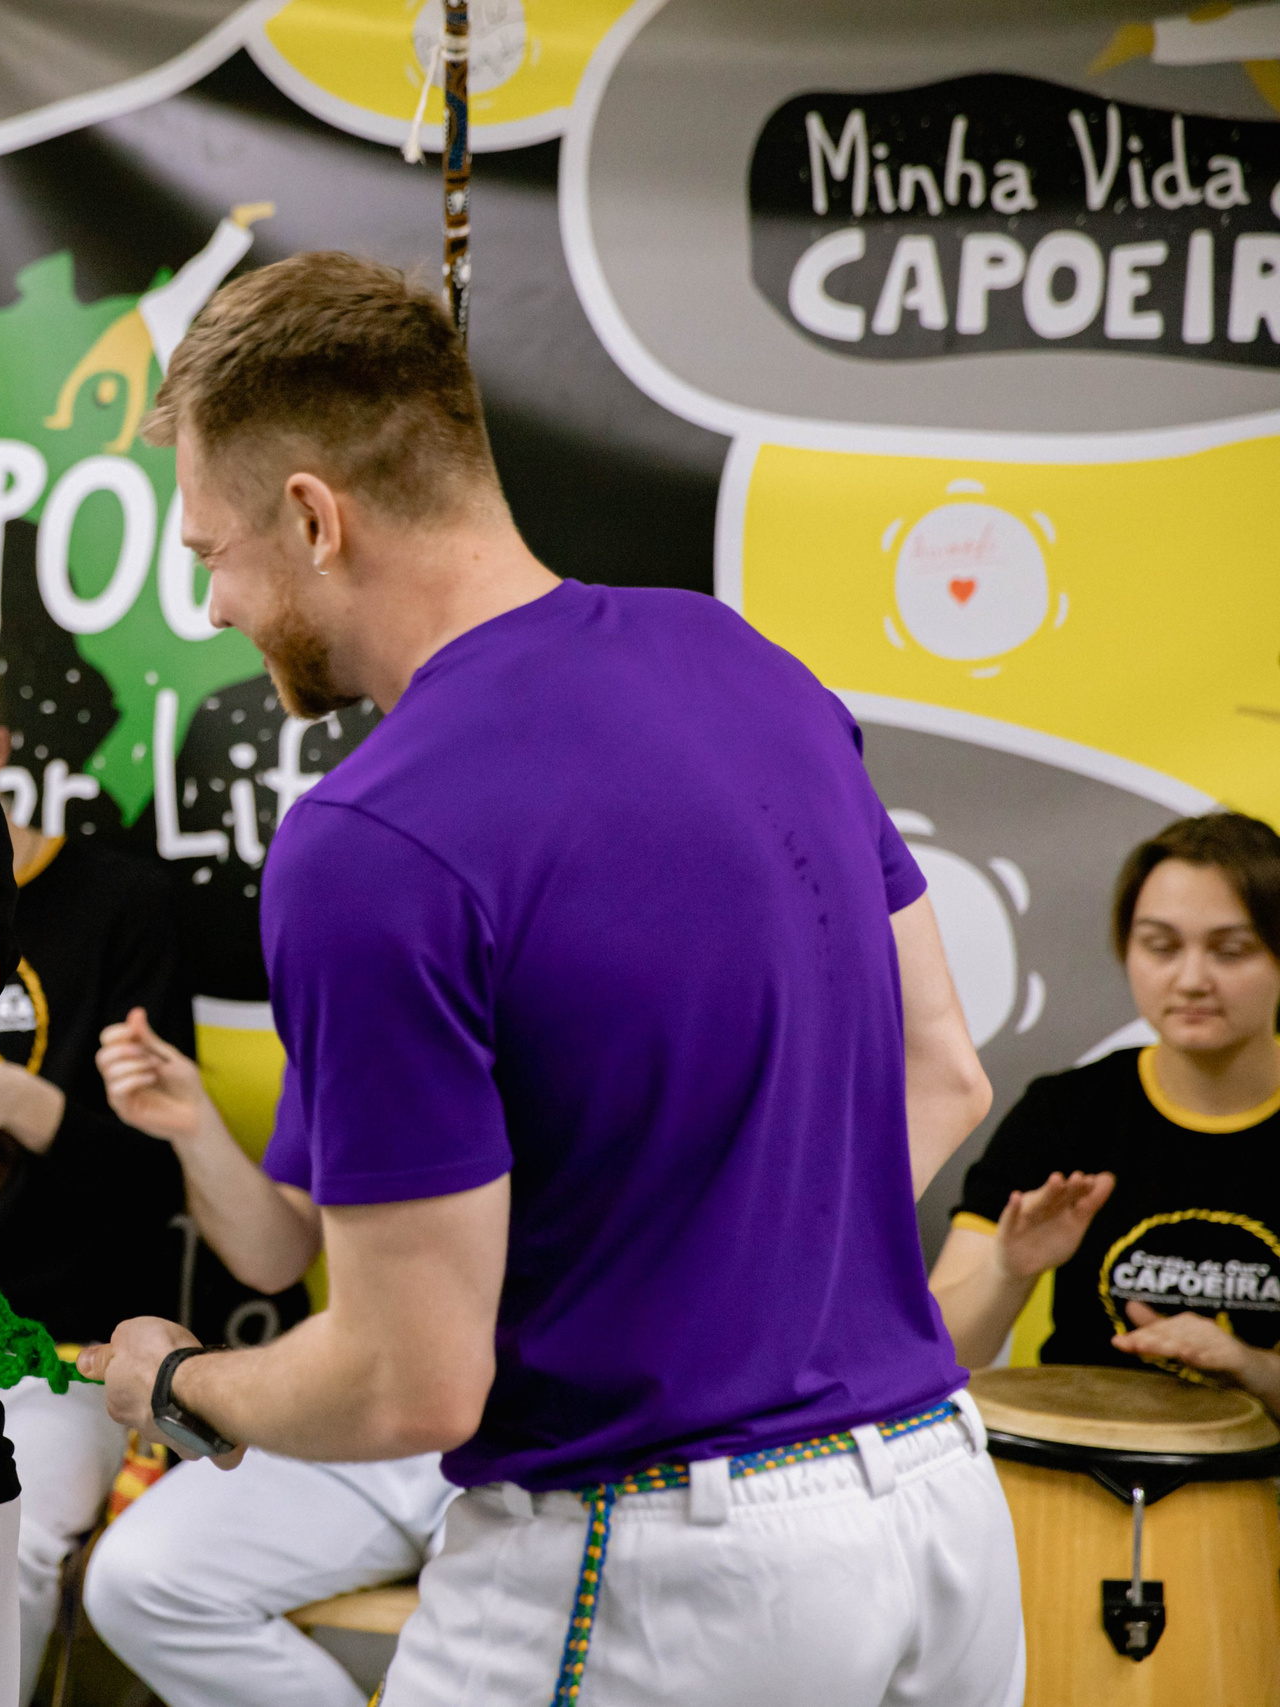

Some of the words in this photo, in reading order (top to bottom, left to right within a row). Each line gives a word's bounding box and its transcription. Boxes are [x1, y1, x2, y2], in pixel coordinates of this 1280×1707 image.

[805, 107, 1037, 216] Minha
[1069, 101, 1252, 212] Vida
[153, 687, 342, 866] Lif
[1113, 1262, 1280, 1300] CAPOEIRA
